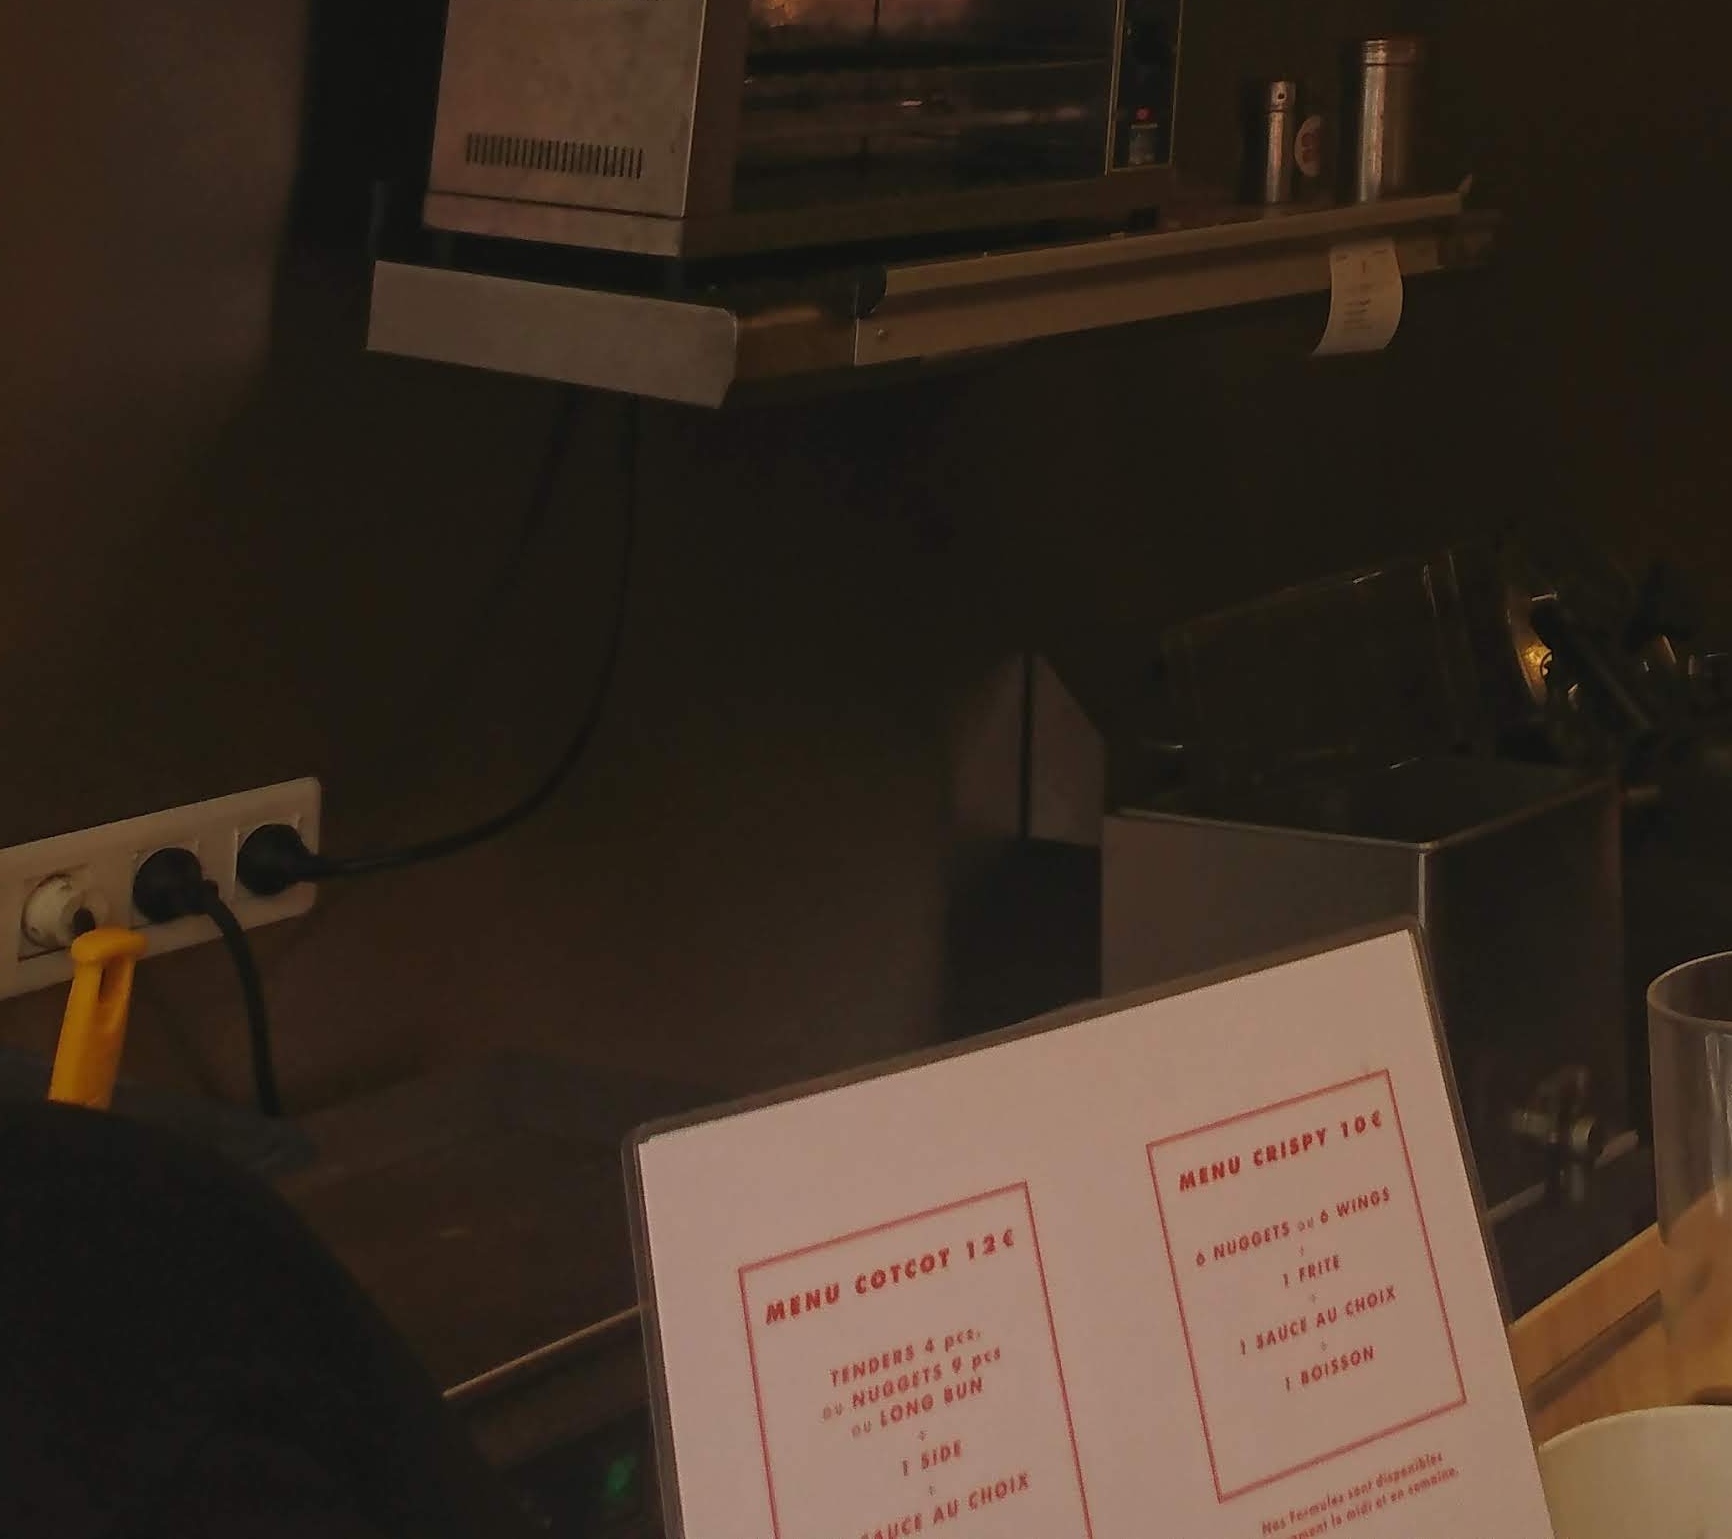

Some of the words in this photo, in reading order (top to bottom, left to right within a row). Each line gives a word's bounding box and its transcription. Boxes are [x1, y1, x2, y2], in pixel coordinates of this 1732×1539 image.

[1179, 1155, 1241, 1192] MENU
[1252, 1127, 1327, 1166] CRISPY
[1212, 1221, 1290, 1260] NUGGETS
[1336, 1186, 1391, 1217] WINGS
[765, 1282, 840, 1325] MENU
[854, 1247, 950, 1295] COTCOT
[1298, 1254, 1340, 1283] FRITE
[1256, 1317, 1307, 1351] SAUCE
[1316, 1306, 1338, 1329] AU
[1344, 1284, 1397, 1316] CHOIX
[830, 1344, 915, 1387] TENDERS
[851, 1362, 942, 1409] NUGGETS
[1301, 1345, 1375, 1386] BOISSON
[880, 1393, 935, 1428] LONG
[943, 1376, 983, 1405] BUN
[967, 1471, 1031, 1511] CHOIX
